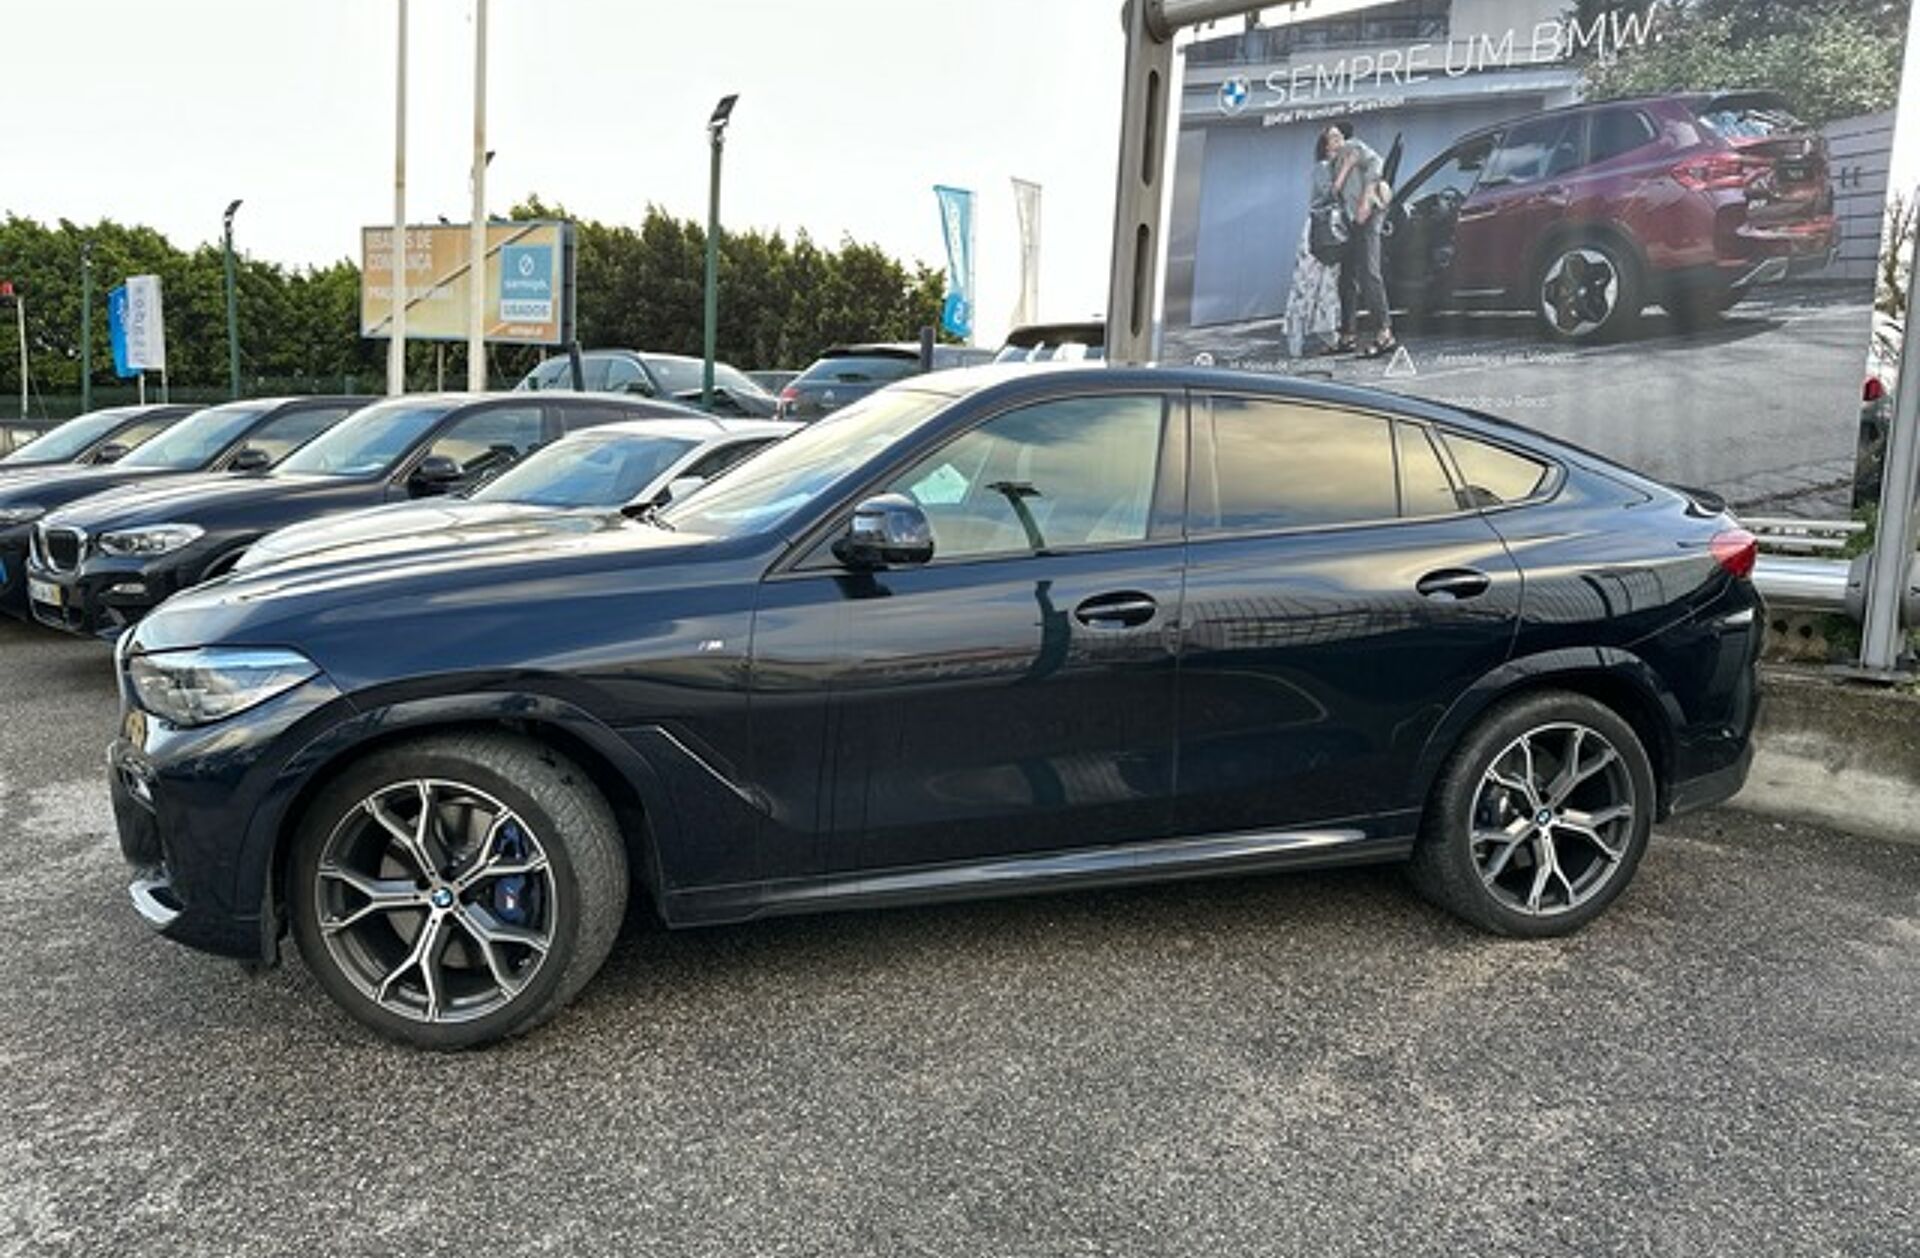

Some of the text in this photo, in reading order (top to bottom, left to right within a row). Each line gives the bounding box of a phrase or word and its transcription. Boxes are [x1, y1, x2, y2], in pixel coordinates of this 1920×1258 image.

[1264, 1, 1663, 108] SEMPRE UM BMW.
[1263, 108, 1295, 127] BMW
[1296, 103, 1346, 121] Premium
